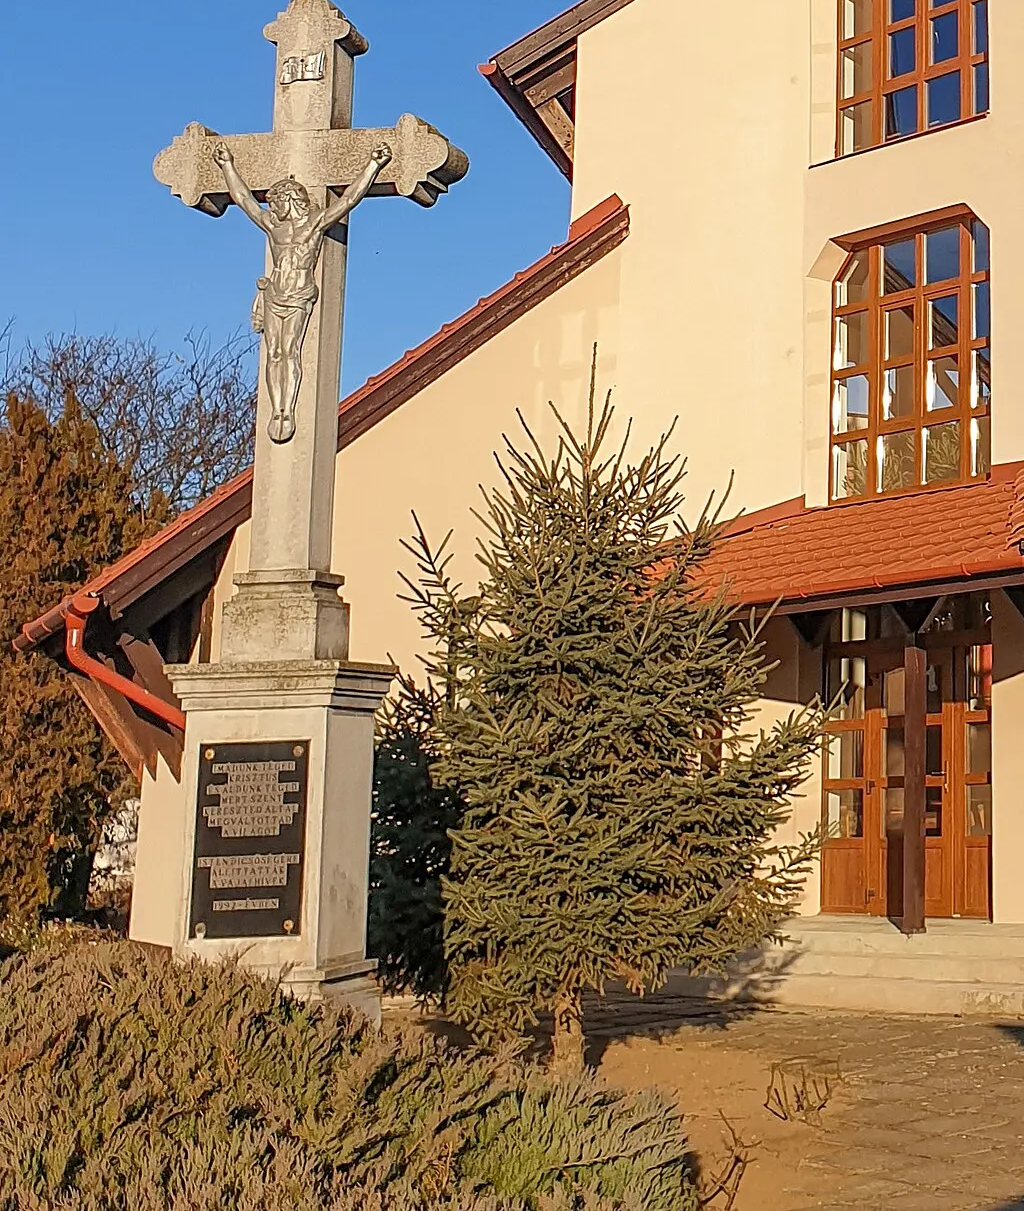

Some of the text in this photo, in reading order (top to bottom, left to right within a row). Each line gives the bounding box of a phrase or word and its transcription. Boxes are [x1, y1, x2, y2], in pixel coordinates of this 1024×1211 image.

[229, 773, 277, 783] KRISZTUS
[222, 794, 282, 804] MERT SZENT
[204, 805, 262, 816] KERESZTED
[199, 857, 228, 868] ISTEN
